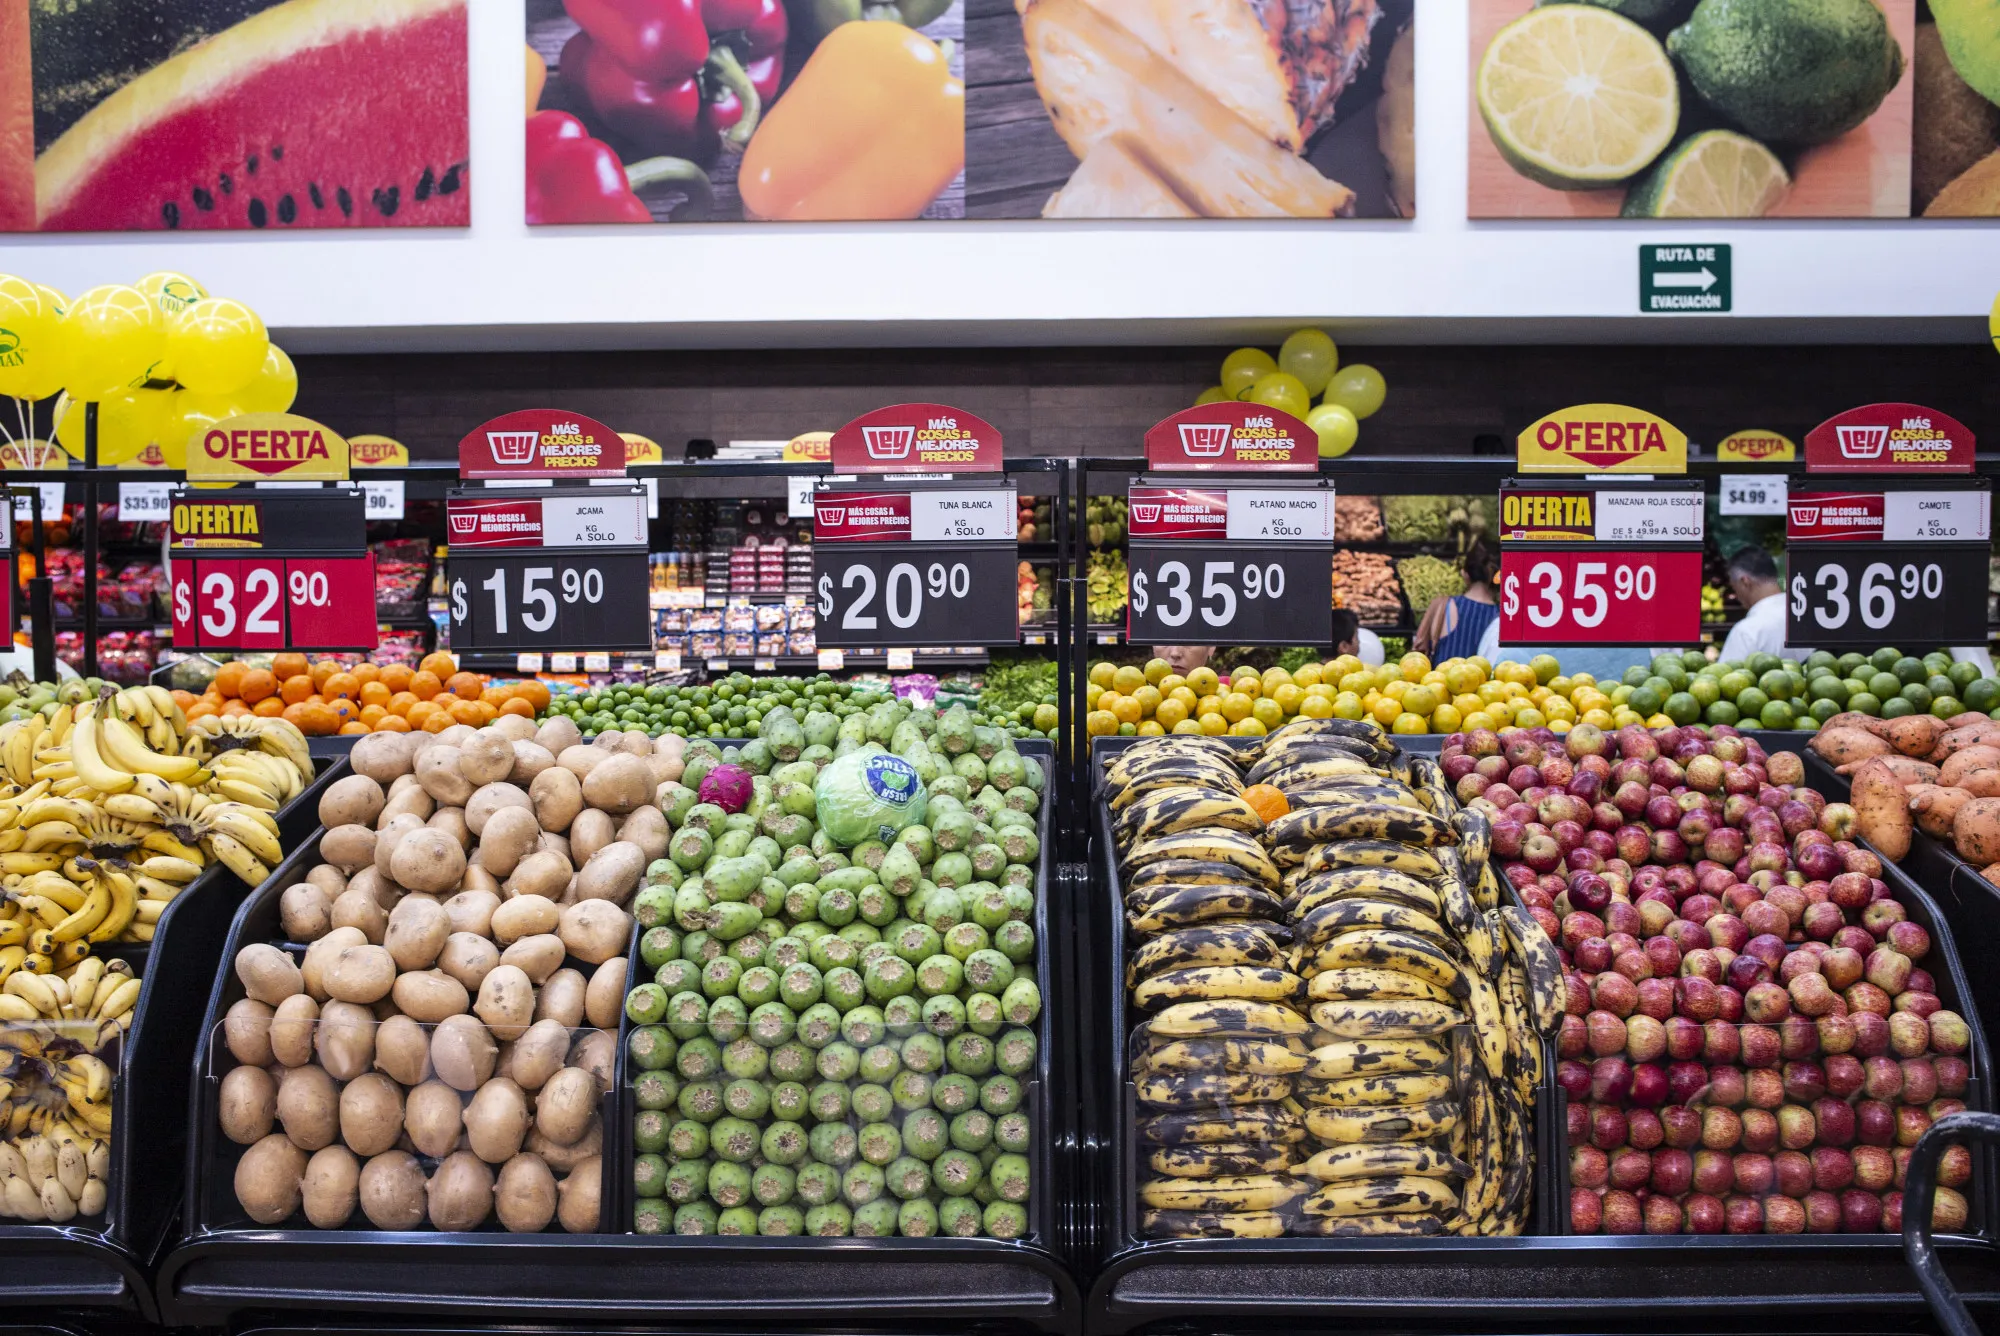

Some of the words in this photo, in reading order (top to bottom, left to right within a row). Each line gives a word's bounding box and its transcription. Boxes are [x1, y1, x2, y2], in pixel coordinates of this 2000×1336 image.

[1656, 248, 1694, 261] RUTA
[1696, 248, 1716, 261] DE
[1650, 292, 1721, 308] EVACUACIÓN
[928, 416, 957, 430] MÁS
[1245, 415, 1273, 428] MÁS
[1902, 416, 1931, 429] MÁS
[552, 422, 580, 434] MÁS
[1233, 428, 1276, 439] COSAS
[1278, 429, 1288, 438] a
[541, 434, 584, 446] COSAS
[585, 435, 594, 444] a
[917, 429, 960, 440] COSAS
[962, 430, 971, 438] a
[1537, 422, 1667, 452] OFERTA
[1891, 429, 1934, 440] COSAS
[1935, 430, 1944, 439] a
[204, 430, 330, 459] OFERTA
[540, 444, 602, 456] MEJORES
[625, 442, 652, 456] RTA
[792, 441, 831, 455] OFER
[916, 440, 979, 451] MEJORES
[1231, 439, 1295, 450] MEJORES
[1727, 438, 1785, 452] OFERTA
[1889, 440, 1952, 451] MEJORES
[353, 444, 399, 457] FERTA
[1236, 450, 1290, 460] PRECIOS
[544, 456, 598, 467] PRECIOS
[920, 451, 974, 462] PRECIOS
[1893, 451, 1948, 462] PRECIOS
[1608, 498, 1645, 506] MANZANA
[1648, 498, 1668, 506] ROJA
[1671, 498, 1703, 506] ESCOLAR
[1729, 490, 1766, 504] $4.99
[939, 502, 959, 510] TUNA
[962, 501, 993, 509] BLANCA
[1164, 504, 1179, 513] MÁS
[1181, 505, 1204, 513] COSAS
[1204, 505, 1210, 513] A
[1250, 501, 1286, 509] PLATANO
[1289, 501, 1316, 509] MACHO
[1919, 502, 1952, 510] CAMOTE
[576, 507, 604, 515] JICAMA
[848, 507, 864, 516] MÁS
[1504, 496, 1592, 526] OFERTA
[1822, 507, 1837, 516] MÁS
[173, 505, 259, 534] OFERTA
[480, 513, 496, 523] MÁS
[496, 514, 520, 522] COSAS
[520, 514, 526, 522] A
[848, 517, 878, 525] MEJORES
[880, 516, 909, 525] PRECIOS
[1163, 515, 1194, 523] MEJORES
[1195, 515, 1225, 523] PRECIOS
[1822, 517, 1852, 526] MEJORES
[1853, 517, 1882, 525] PRECIOS
[481, 523, 511, 532] MEJORES
[512, 522, 541, 532] PRECIOS
[956, 527, 984, 535] SOLO
[1261, 527, 1268, 535] A
[1273, 527, 1302, 535] SOLO
[1673, 527, 1700, 535] SOLO
[1917, 528, 1924, 536] A
[1929, 528, 1957, 536] SOLO
[587, 533, 615, 541] SOLO
[818, 572, 834, 621] $
[842, 562, 923, 630] 20
[1132, 568, 1148, 618] $
[1156, 560, 1238, 628] 35
[1503, 572, 1520, 621] $
[1527, 562, 1608, 628] 35
[1790, 572, 1808, 622] $
[1814, 562, 1896, 630] 36
[175, 579, 191, 627] $
[201, 568, 280, 637] 32
[452, 578, 468, 626] $
[483, 567, 557, 634] 15
[881, 788, 908, 803] FRESH
